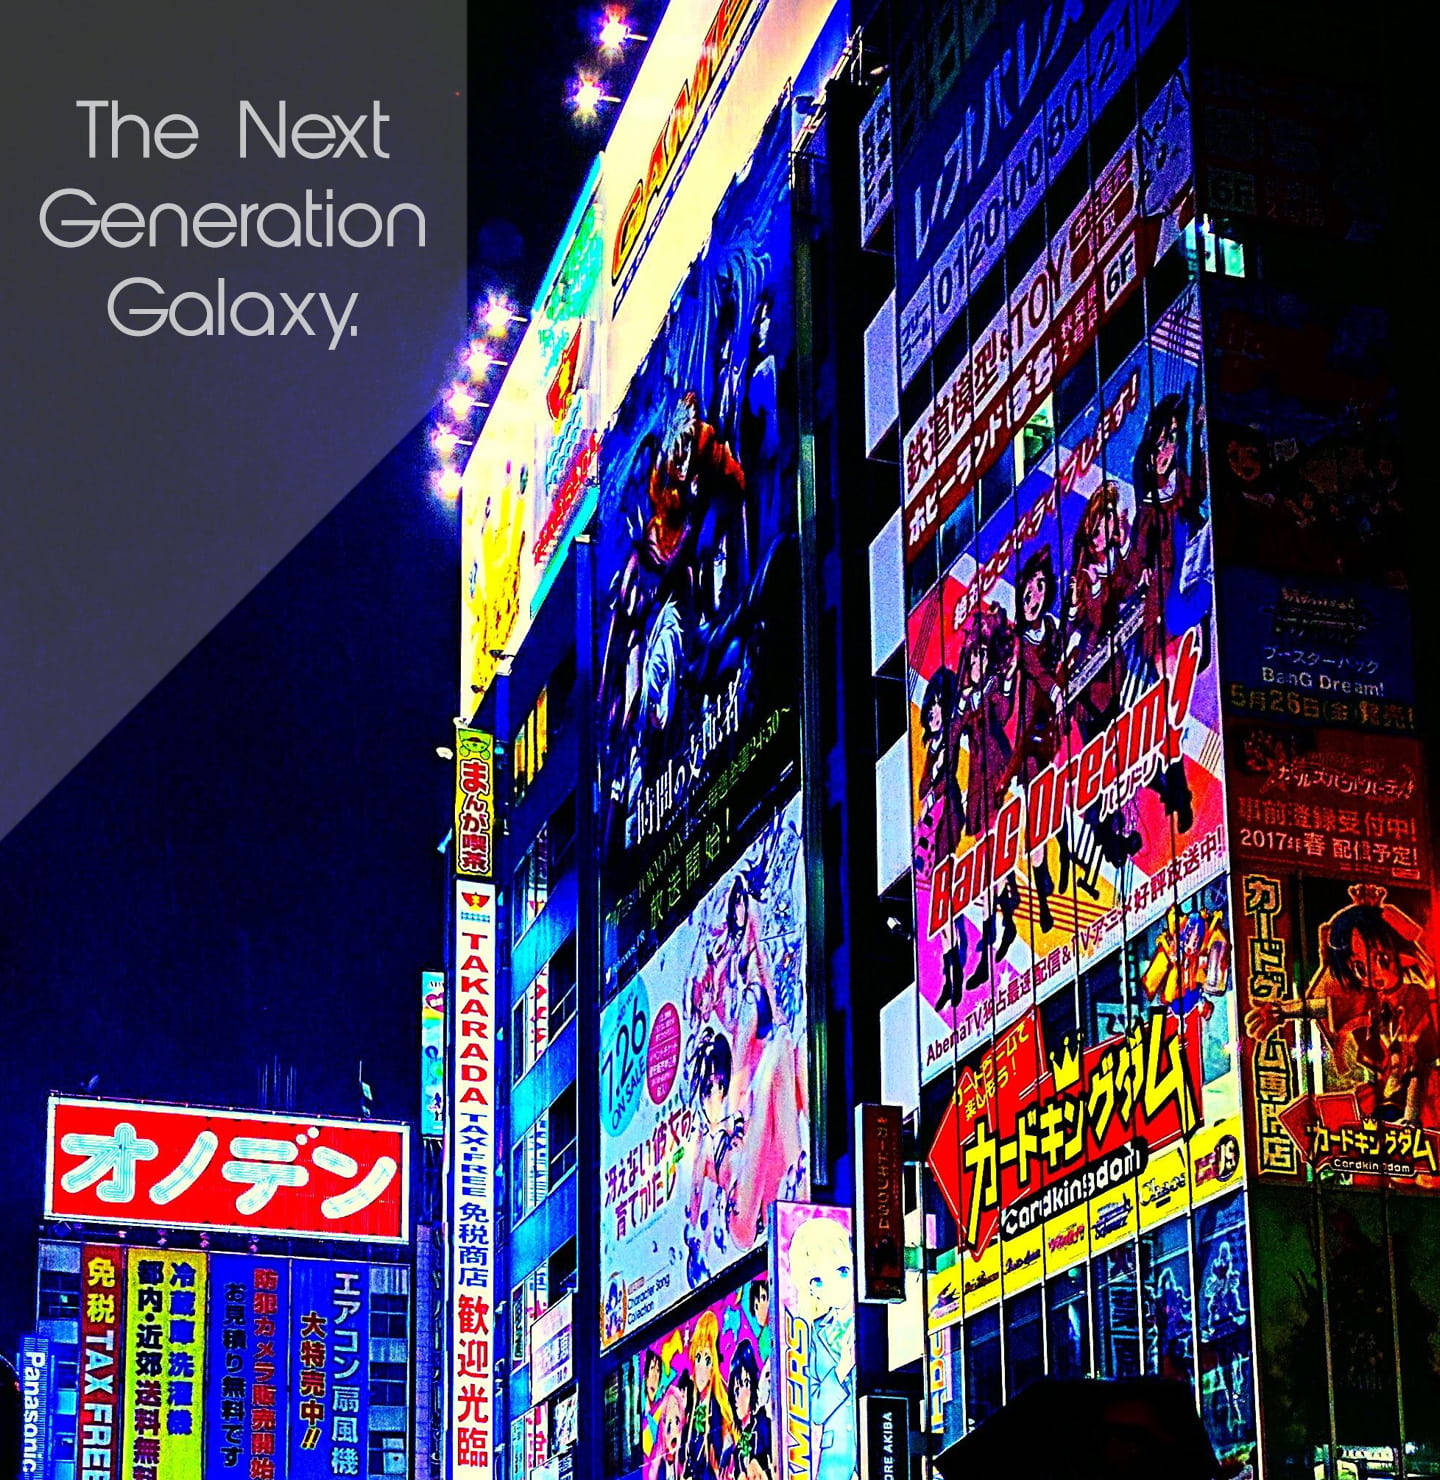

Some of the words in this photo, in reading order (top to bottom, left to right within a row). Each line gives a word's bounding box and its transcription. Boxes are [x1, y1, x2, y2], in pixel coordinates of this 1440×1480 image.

[1106, 245, 1135, 300] 6F
[1262, 666, 1313, 688] BanG
[1319, 673, 1385, 697] Dream!
[461, 759, 489, 872] まんが喫茶
[460, 931, 490, 1106] TAKARADA
[1247, 878, 1294, 1170] カードゲム専門店
[60, 1122, 398, 1220] オノデン
[965, 1013, 1196, 1246] カードキングダム
[1333, 1157, 1411, 1174] Cardkindom
[86, 1256, 115, 1325] 免税
[458, 1202, 490, 1288] 免税商店
[85, 1330, 115, 1395] TAX
[457, 1294, 489, 1467] 歓迎光臨
[23, 1350, 46, 1473] Panasonic
[883, 1411, 893, 1454] AKIBA
